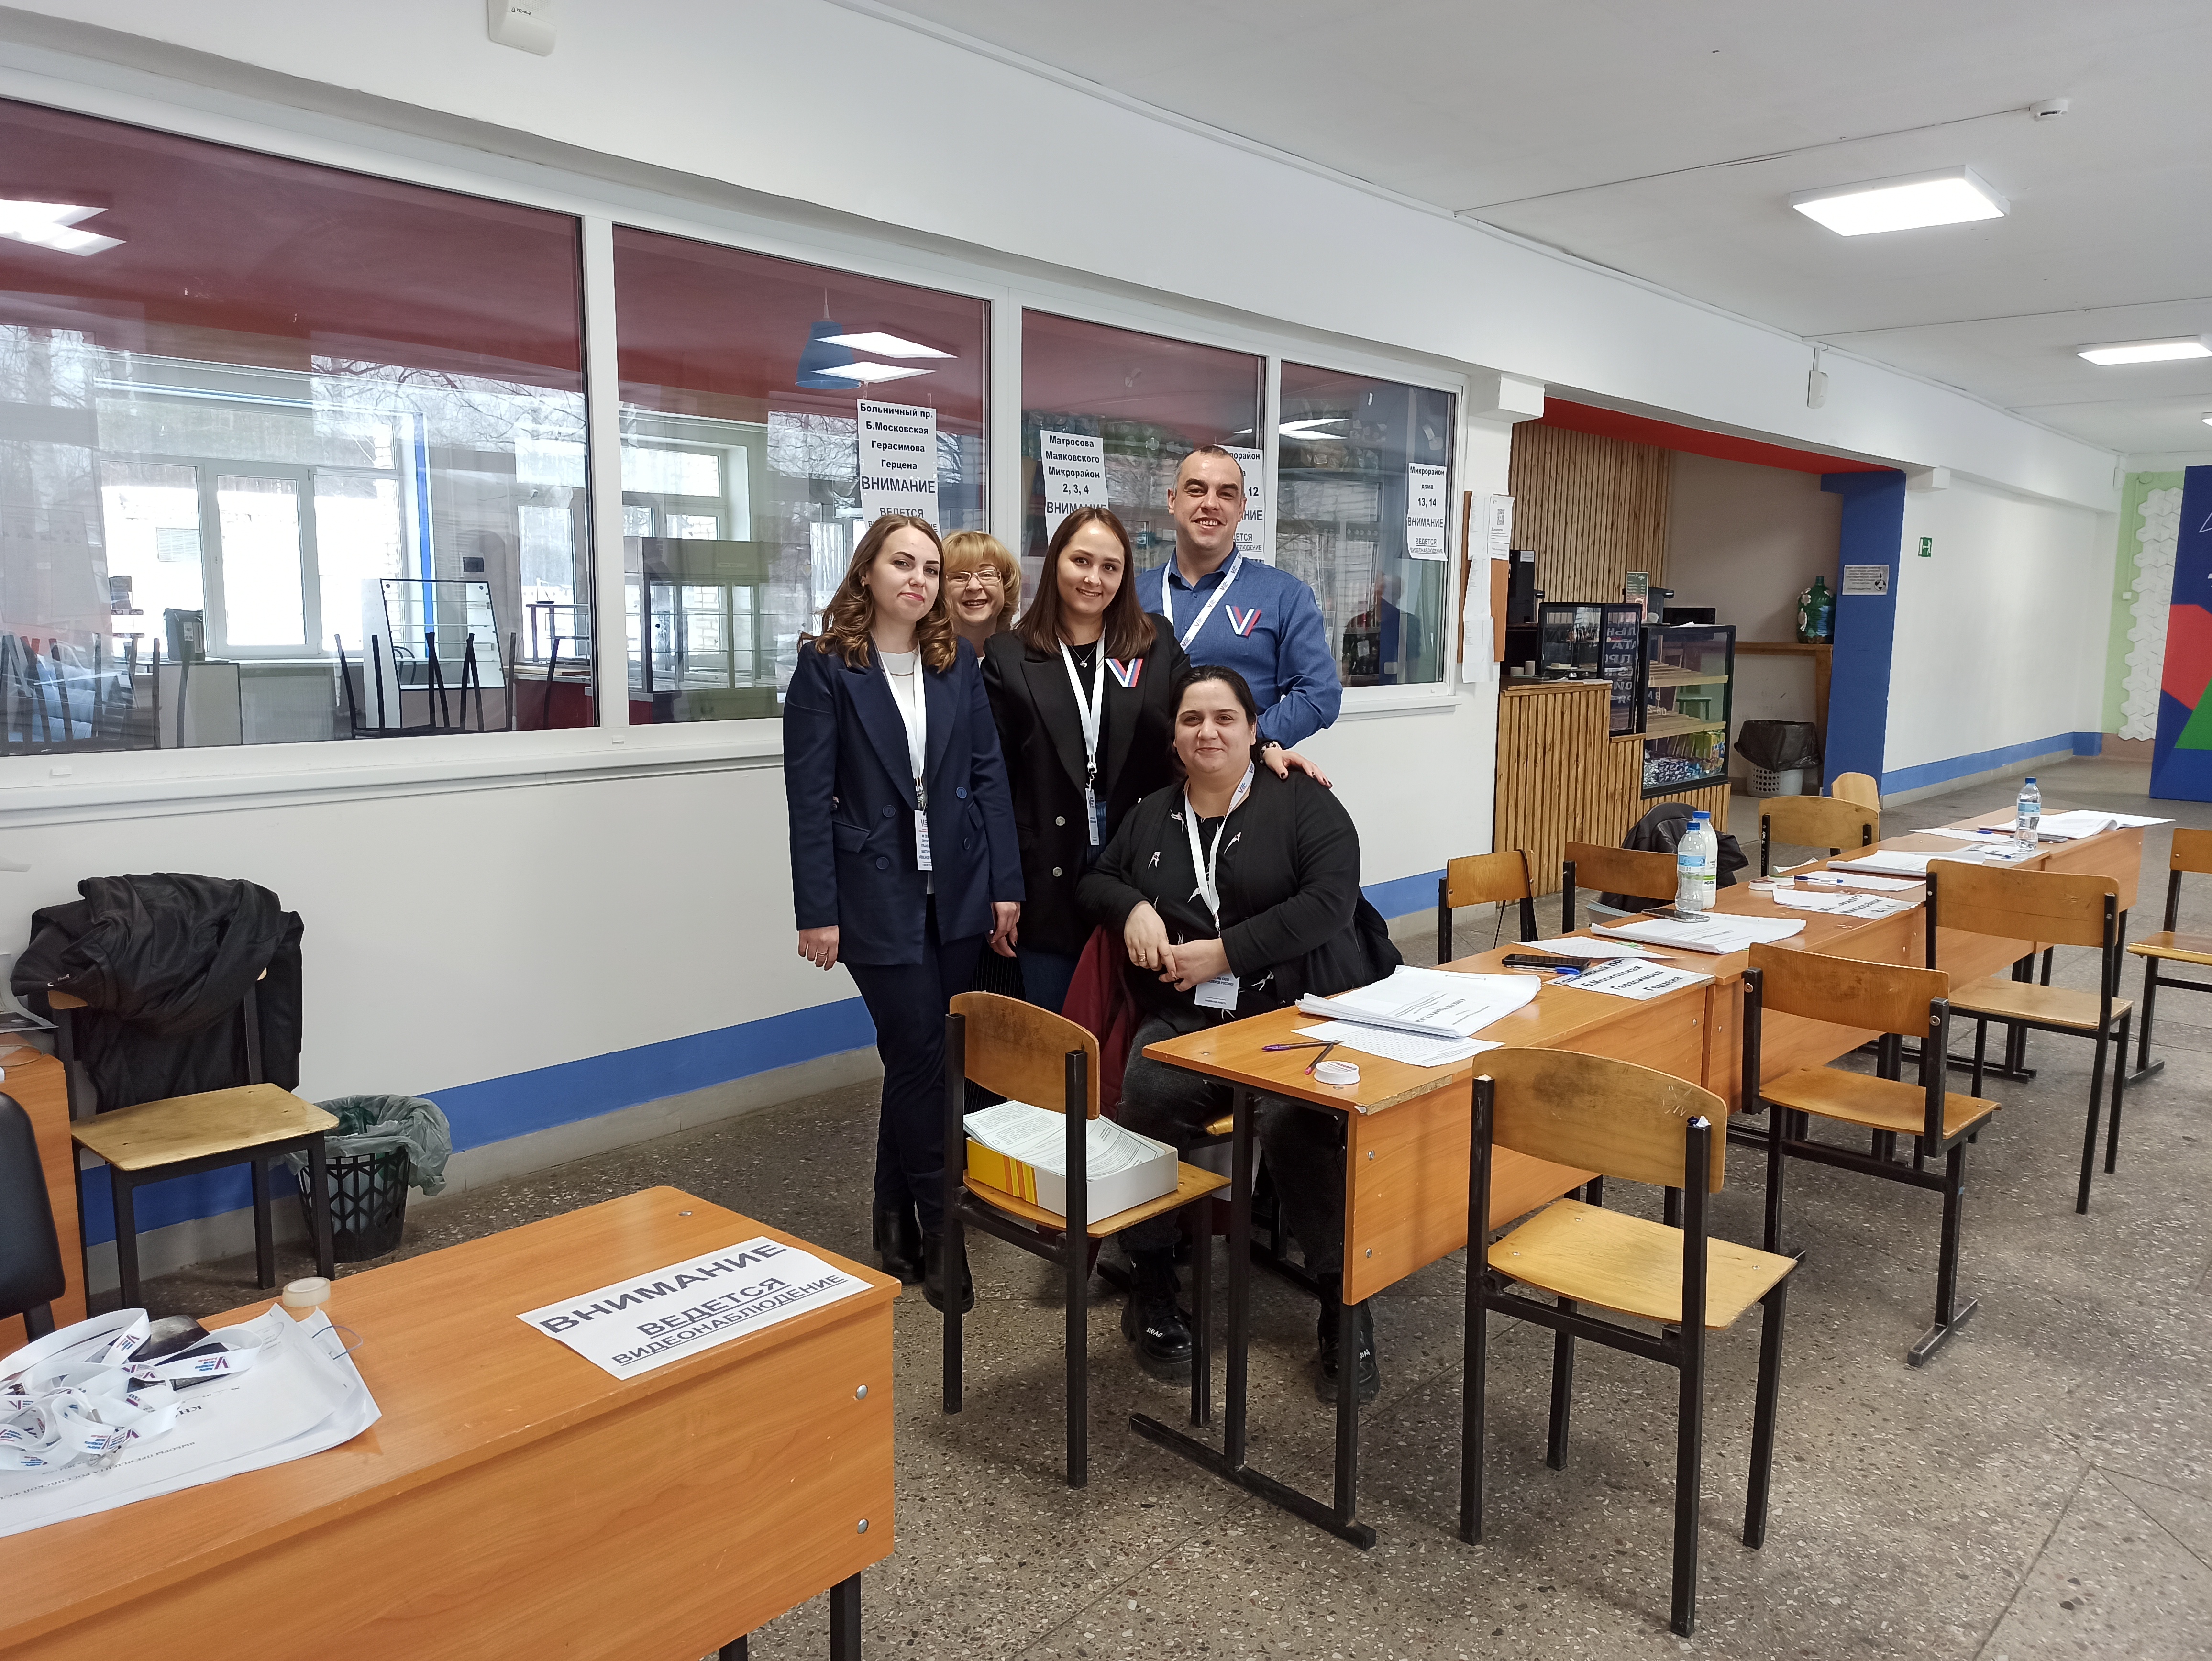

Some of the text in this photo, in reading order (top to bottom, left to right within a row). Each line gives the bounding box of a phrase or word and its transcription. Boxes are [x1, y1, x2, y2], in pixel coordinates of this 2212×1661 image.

[860, 403, 933, 419] Больничный пр.
[866, 421, 929, 434] Б.Московская
[872, 440, 925, 452] Герасимова
[1049, 435, 1094, 447] Матросова
[1045, 450, 1100, 463] Маяковского
[881, 459, 918, 470] Герцена
[1410, 466, 1445, 476] Микрорайон
[1048, 466, 1100, 479] Микрорайон
[861, 476, 936, 494] ВНИМАНИЕ
[1063, 483, 1089, 496] 2, 3, 4
[1417, 498, 1437, 508] 13, 14
[1407, 517, 1444, 528] ВНИМАНИЕ
[1415, 538, 1437, 546] ВЕДЕТСЯ
[1581, 964, 1643, 987] Б.Московская
[1610, 970, 1664, 990] Герасимова
[1642, 975, 1684, 992] Герцена
[539, 1244, 787, 1333] ВНИМАНИЕ
[636, 1277, 787, 1337] ВЕДЕТСЯ
[611, 1274, 845, 1364] ВИДЕОНАБЛЮДЕНИЕ
